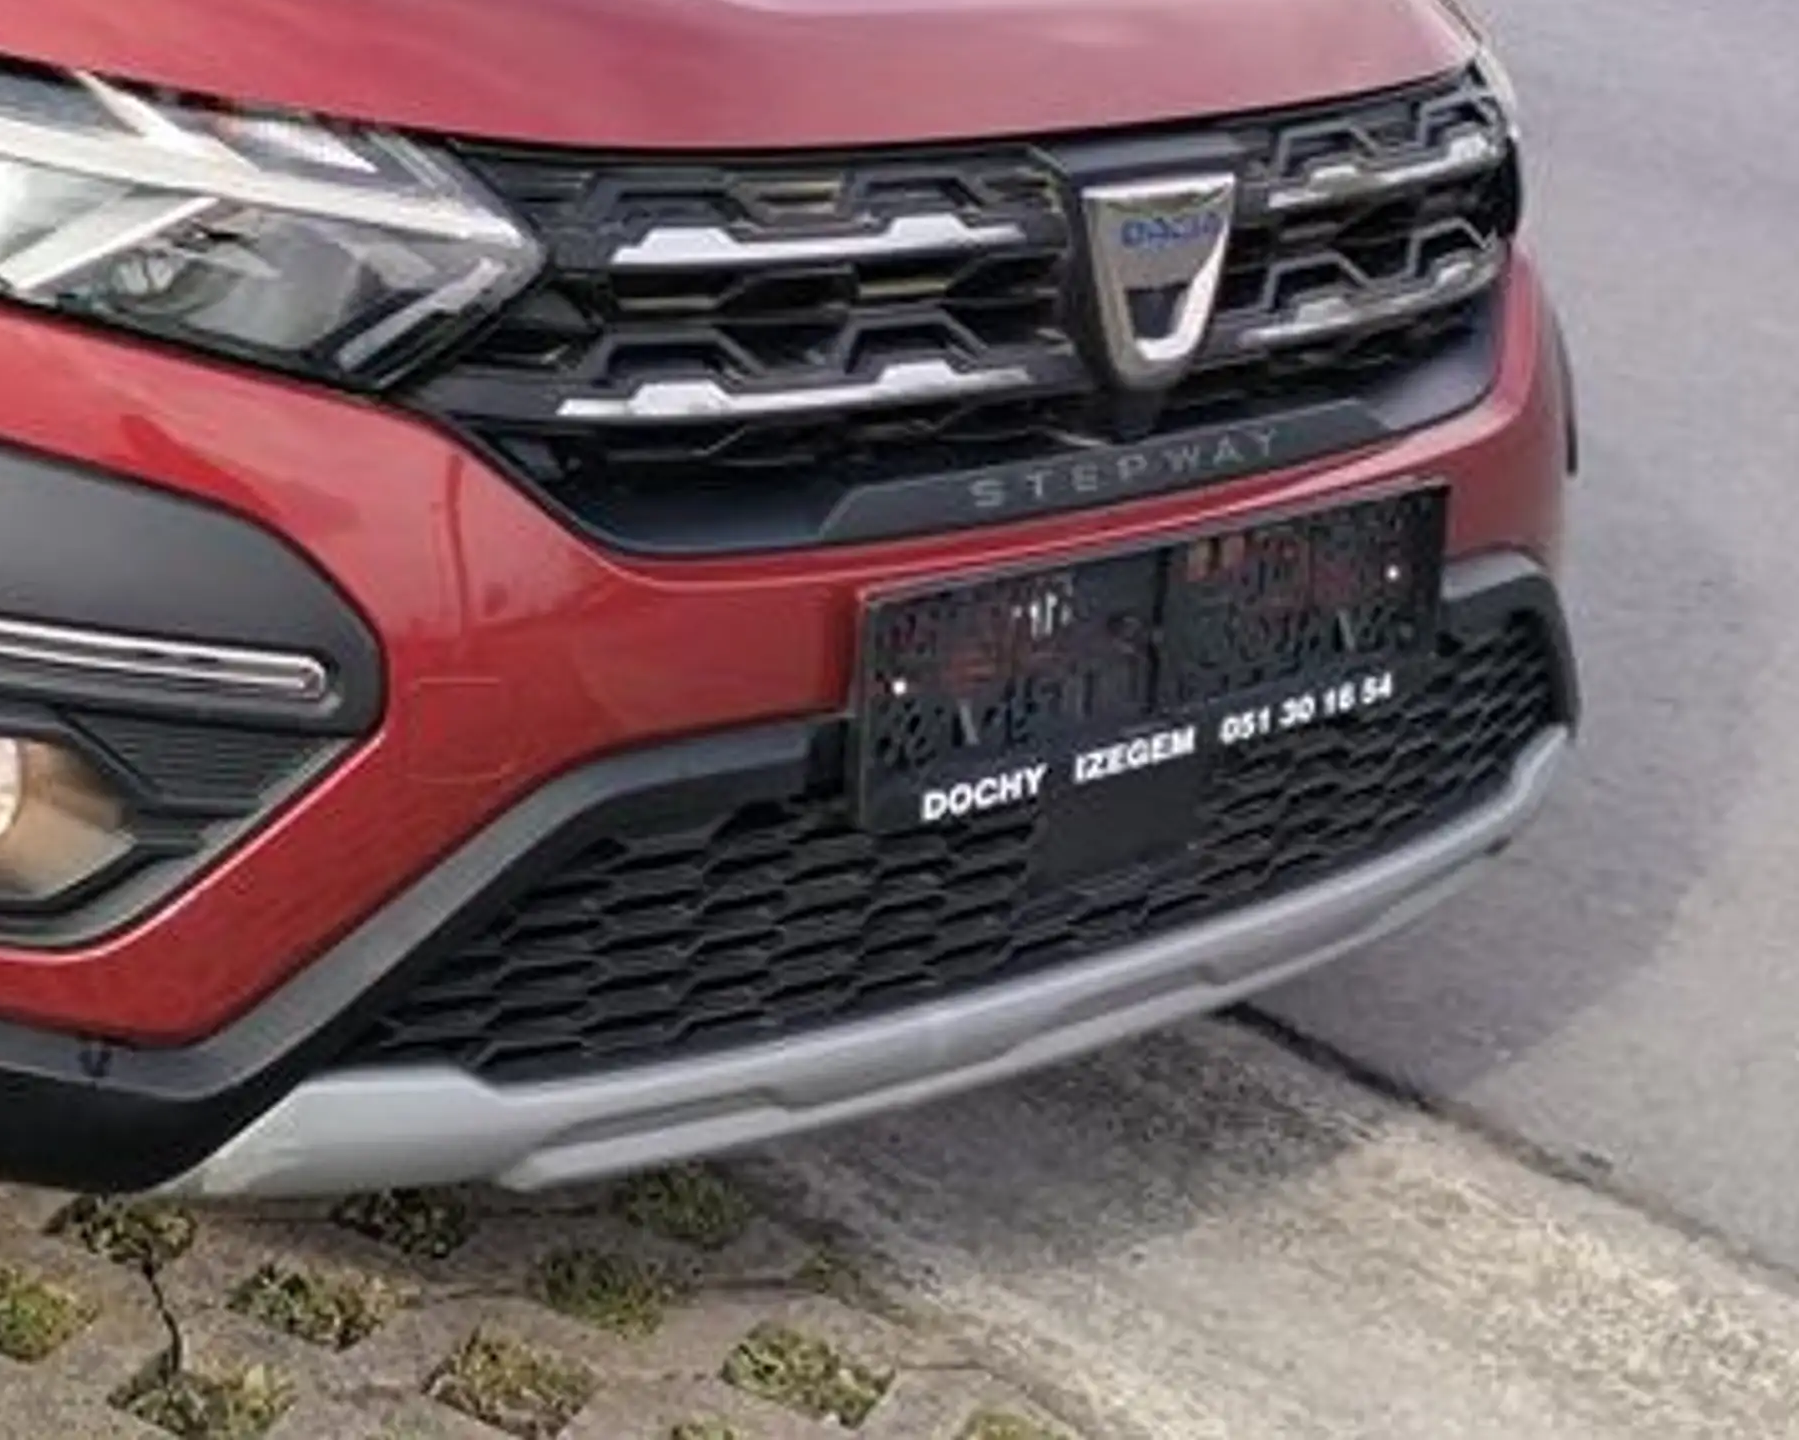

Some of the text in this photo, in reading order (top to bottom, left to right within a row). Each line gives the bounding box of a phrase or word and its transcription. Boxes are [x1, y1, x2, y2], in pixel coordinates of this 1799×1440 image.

[966, 427, 1278, 509] STEPWAY
[920, 763, 1048, 821] DOCHY
[1073, 724, 1196, 785] IZEGEM
[1218, 705, 1271, 745] 051
[1278, 690, 1317, 730] 30
[1361, 671, 1394, 705] 54
